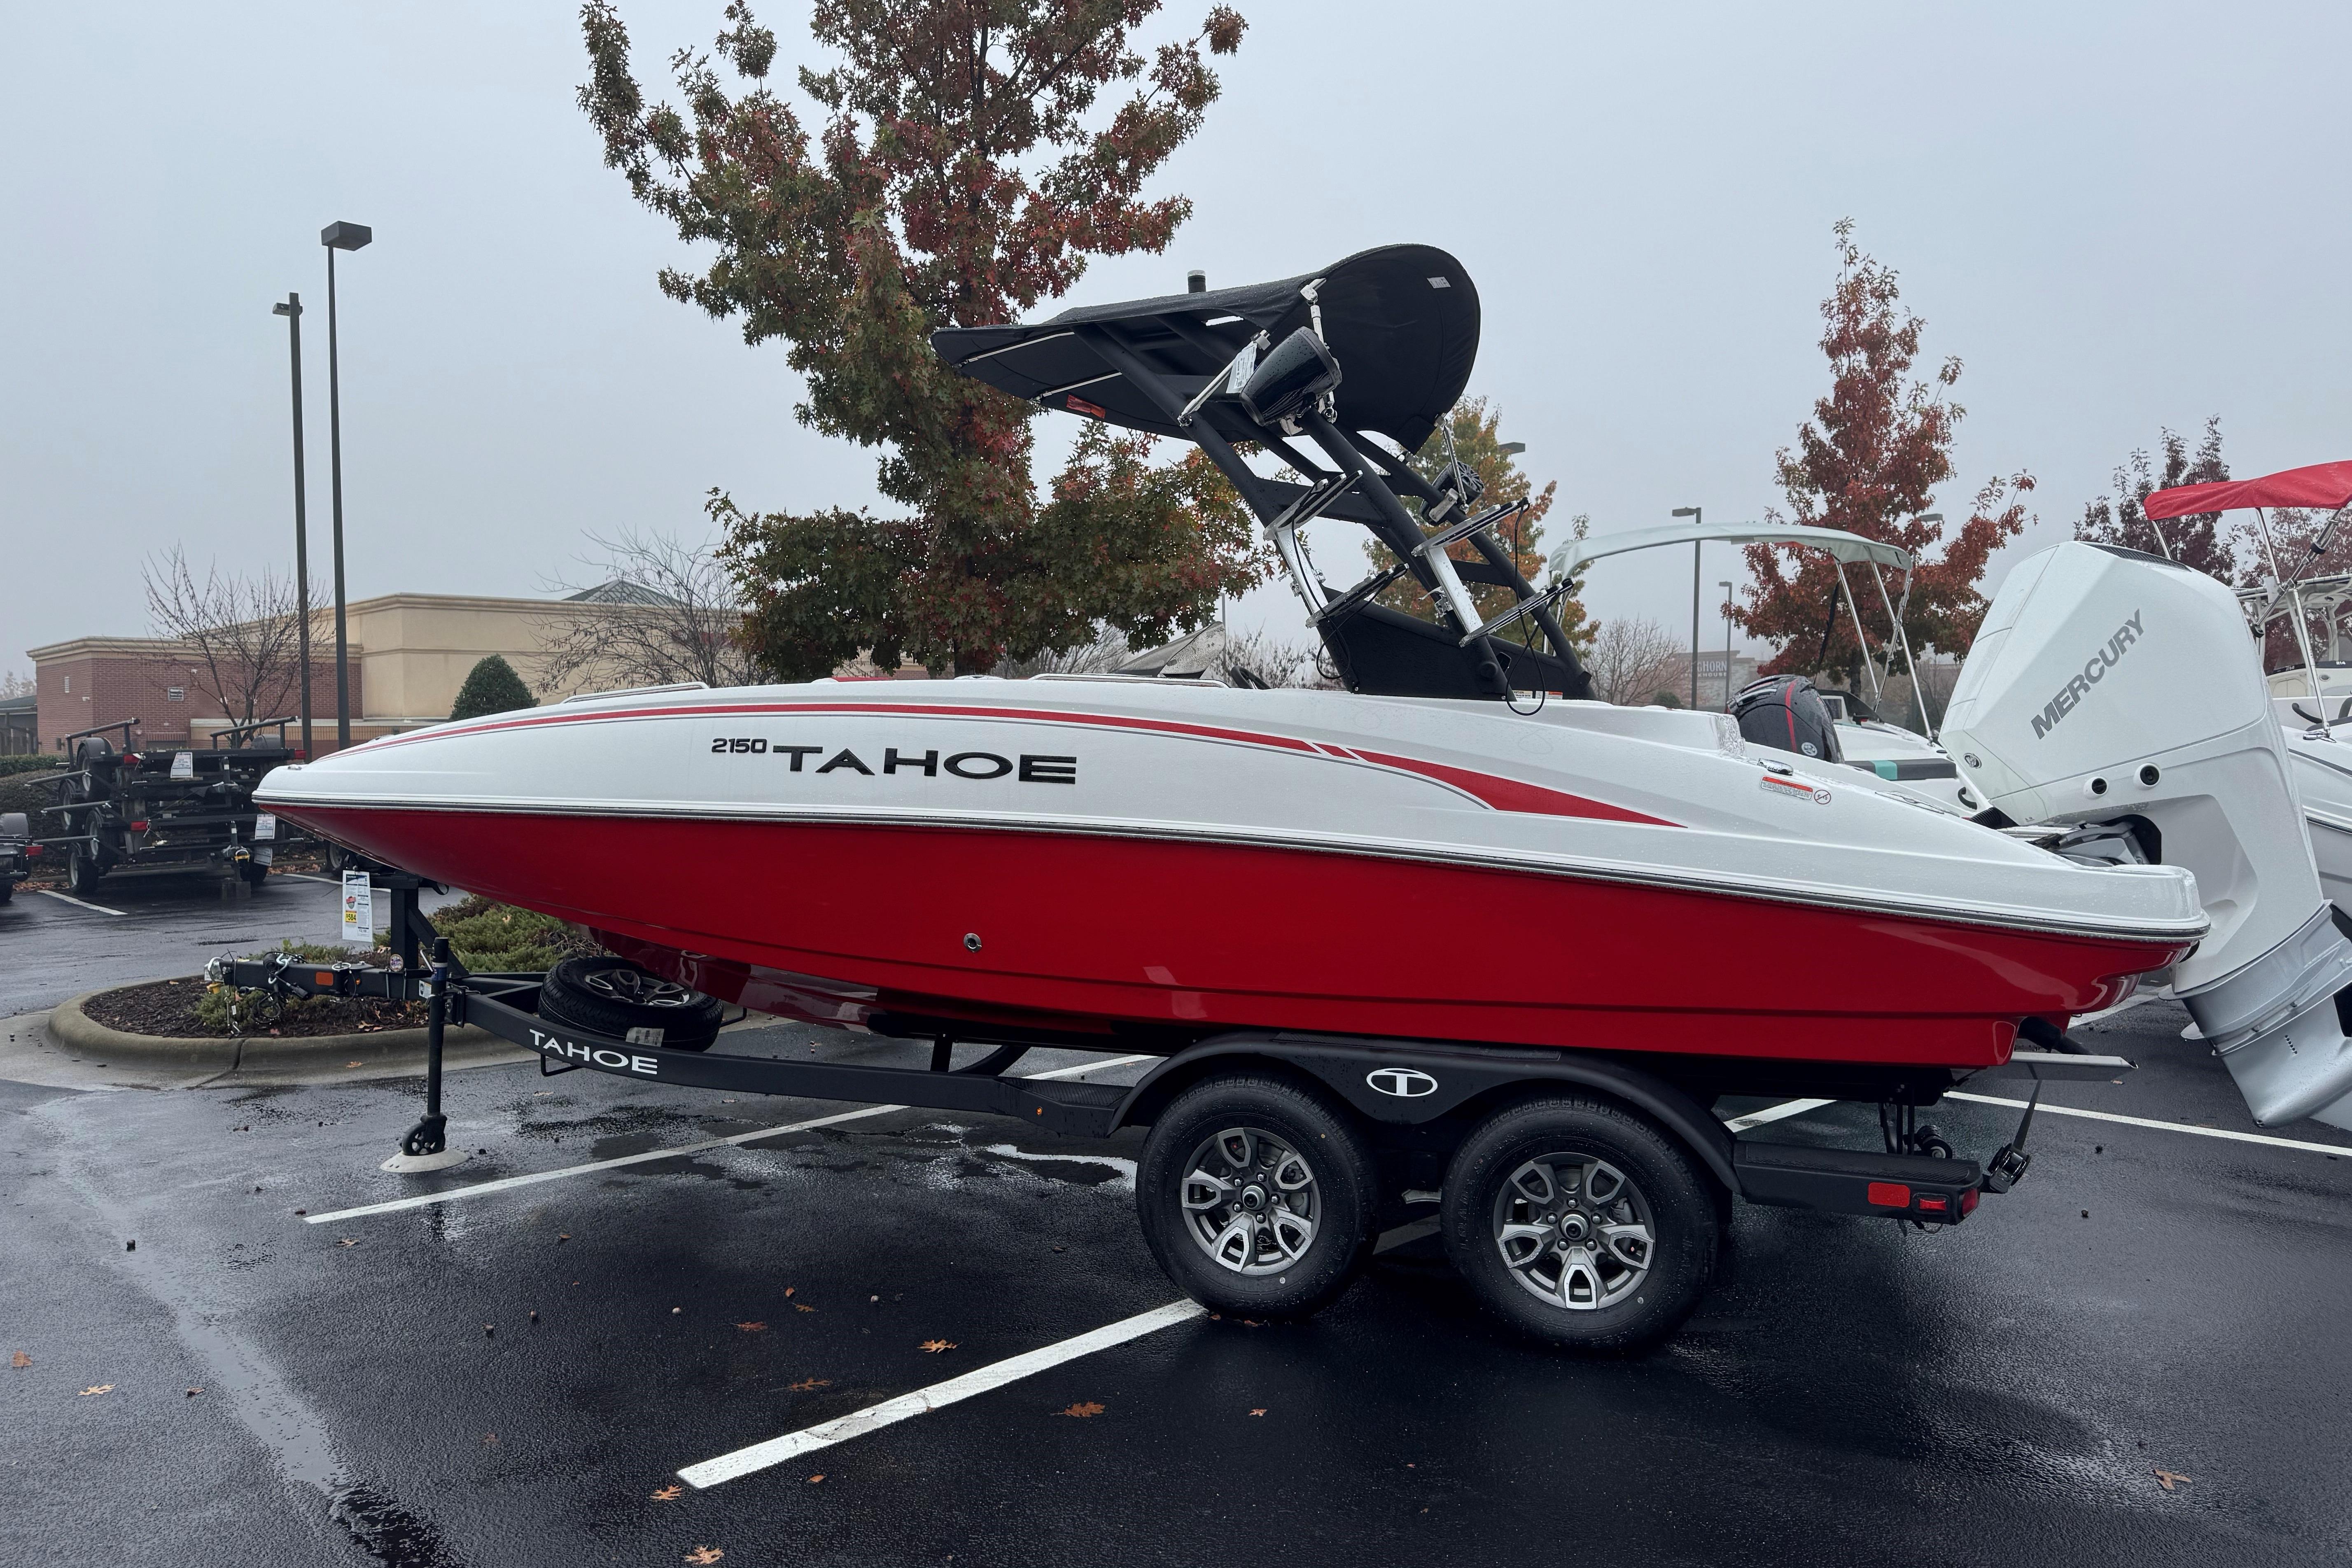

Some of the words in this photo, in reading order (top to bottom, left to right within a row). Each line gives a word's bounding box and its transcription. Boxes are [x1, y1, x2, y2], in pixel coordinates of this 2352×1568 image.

[2031, 608, 2144, 740] MERCURY
[712, 738, 767, 754] 2150
[772, 745, 1077, 785] TAHOE
[529, 1028, 658, 1075] TAHOE
